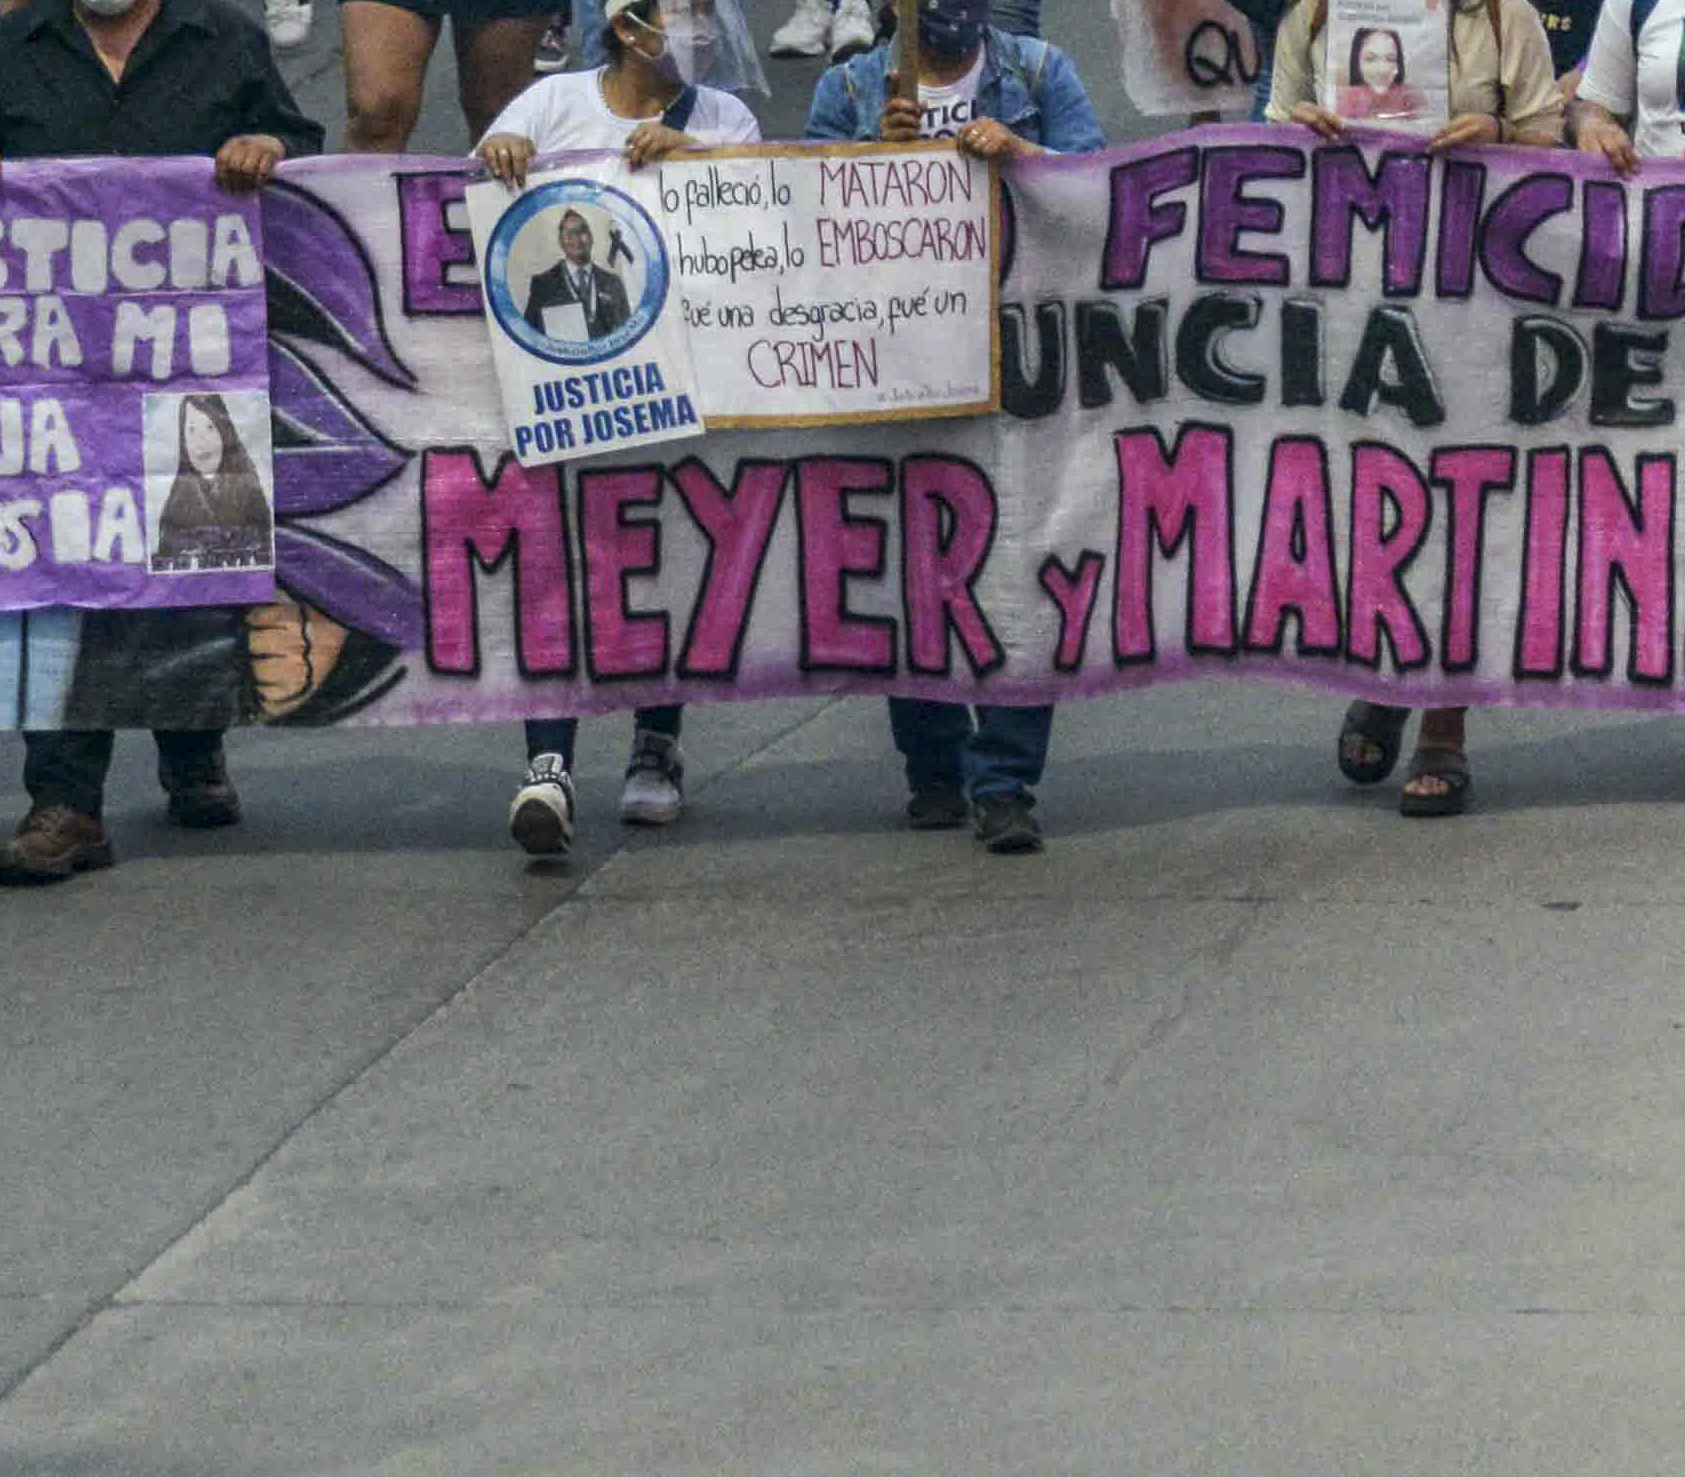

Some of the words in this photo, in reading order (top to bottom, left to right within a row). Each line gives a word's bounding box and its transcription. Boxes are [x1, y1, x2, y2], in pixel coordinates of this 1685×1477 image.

[819, 159, 974, 209] MATARON
[817, 218, 987, 267] EMBOSCARON
[718, 307, 756, 329] una
[934, 288, 968, 317] un
[109, 301, 231, 380] MI
[747, 338, 881, 390] CRIMEN
[532, 361, 667, 416] JUSTICIA
[1509, 313, 1677, 428] DE
[515, 418, 576, 458] POR
[582, 392, 698, 445] JOSEMA
[420, 445, 1007, 683] MEYER
